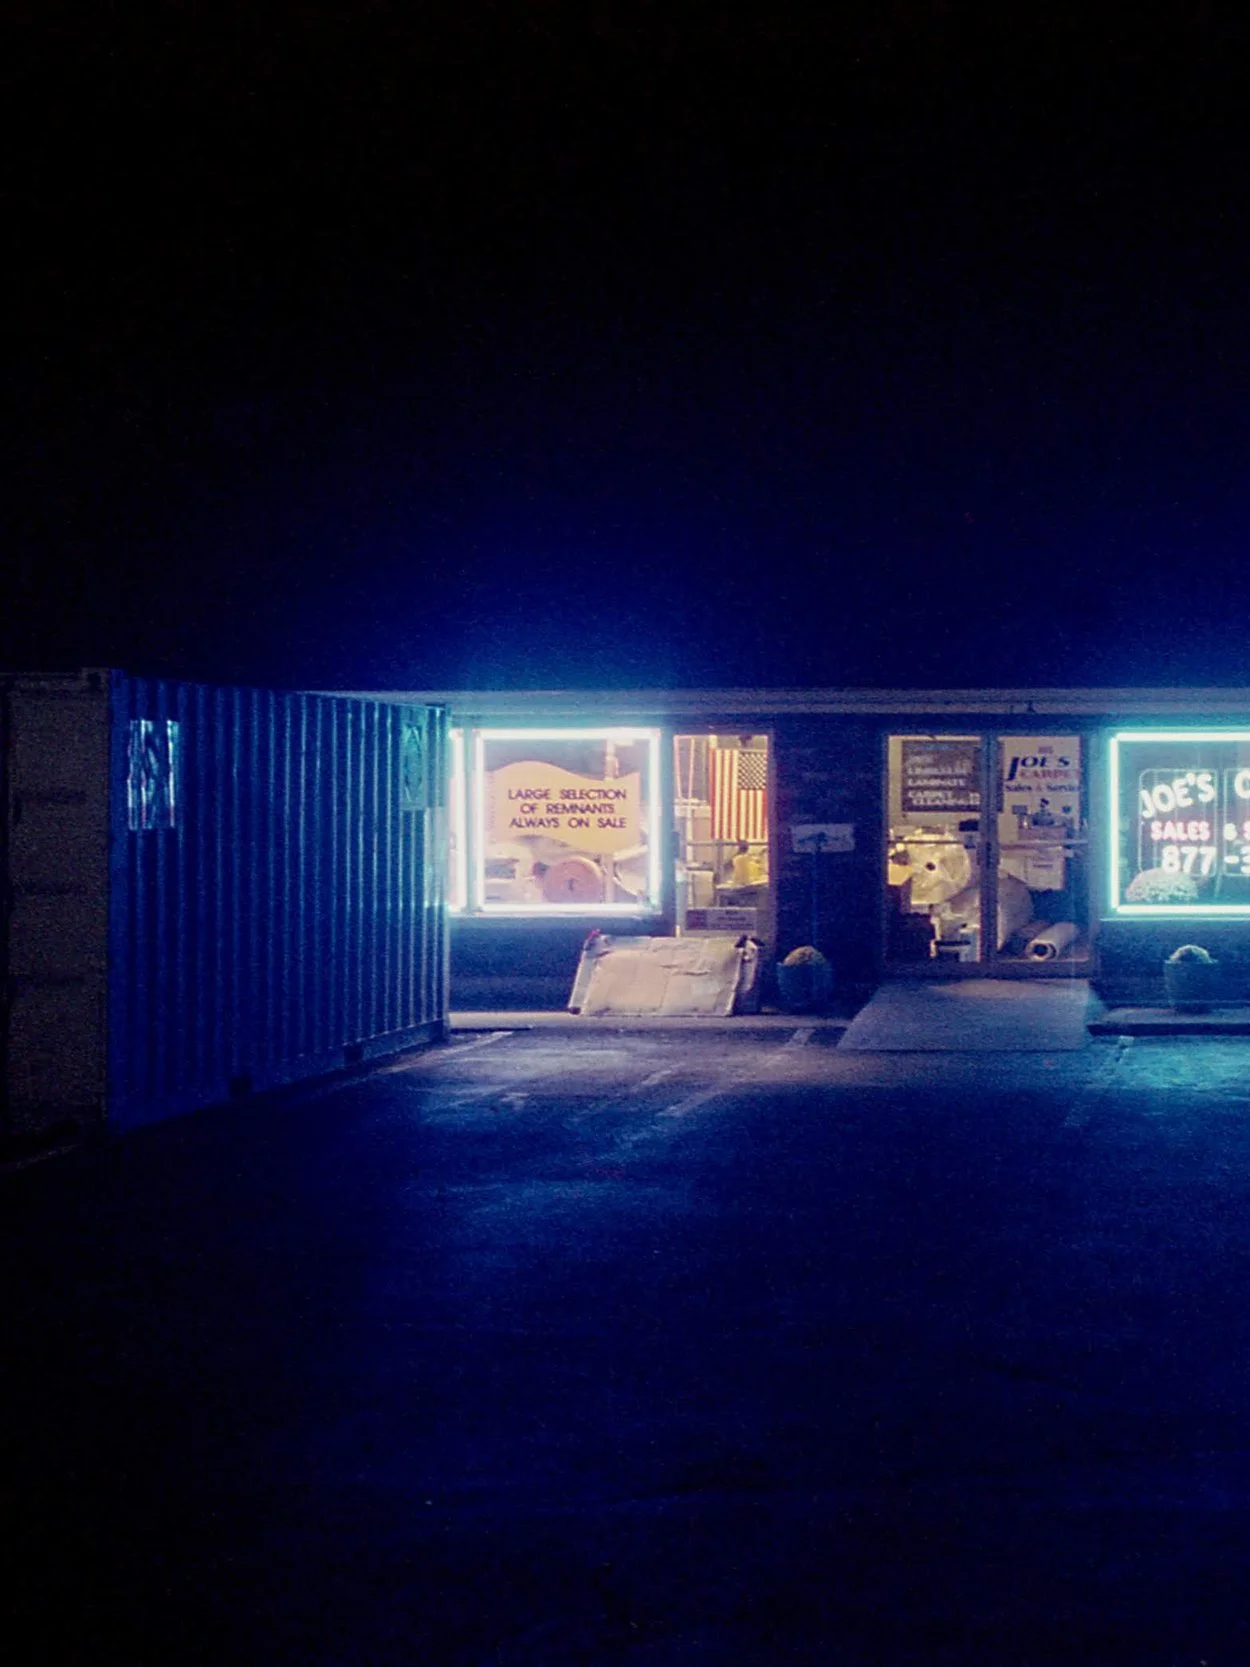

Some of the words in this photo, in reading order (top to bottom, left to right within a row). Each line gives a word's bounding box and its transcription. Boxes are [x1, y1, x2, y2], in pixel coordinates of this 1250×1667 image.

[508, 789, 550, 800] LARGE
[560, 789, 626, 800] SELECTION
[1140, 773, 1215, 818] JOE'S
[520, 803, 539, 814] OF
[546, 803, 614, 814] REMNANTS
[510, 818, 559, 828] ALWAYS
[568, 818, 589, 828] ON
[598, 818, 627, 828] SALE
[1150, 821, 1210, 841] SALES
[1223, 823, 1237, 841] &
